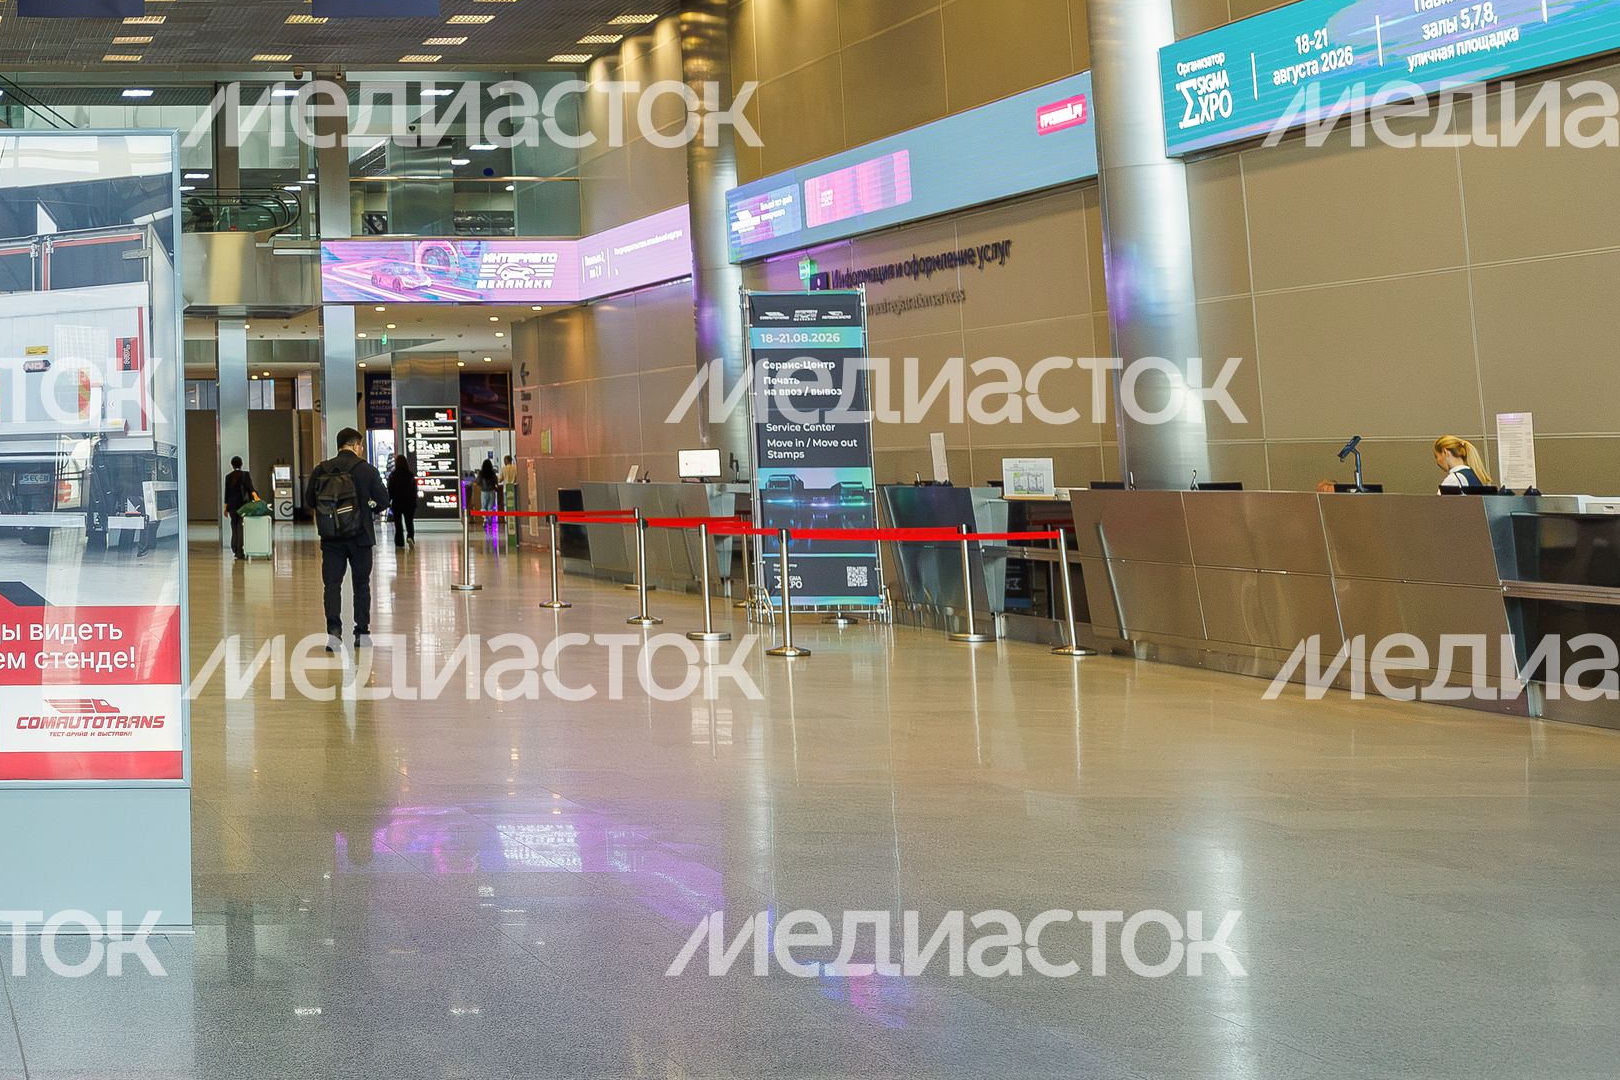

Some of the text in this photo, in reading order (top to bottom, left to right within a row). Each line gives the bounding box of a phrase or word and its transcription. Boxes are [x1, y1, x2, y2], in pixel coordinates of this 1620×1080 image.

[1422, 15, 1457, 41] залы
[1407, 26, 1519, 73] уличная площадка
[1177, 52, 1225, 76] Организатор
[1272, 46, 1354, 87] августа 2026
[1197, 69, 1229, 96] SIGMA
[482, 252, 558, 263] ИНТЕРАВТО
[976, 239, 1012, 270] услуг
[477, 279, 552, 289] МЕХАНИКА
[763, 361, 836, 371] Сервис-Центр
[764, 377, 800, 386] Печать
[811, 387, 842, 396] вывоз
[766, 423, 836, 432] Service Center
[767, 438, 858, 448] Move in Move out
[767, 450, 805, 461] Stamps
[29, 622, 123, 644] видеть
[34, 646, 136, 672] стенде!
[16, 715, 165, 729] COMAUTOTRANS
